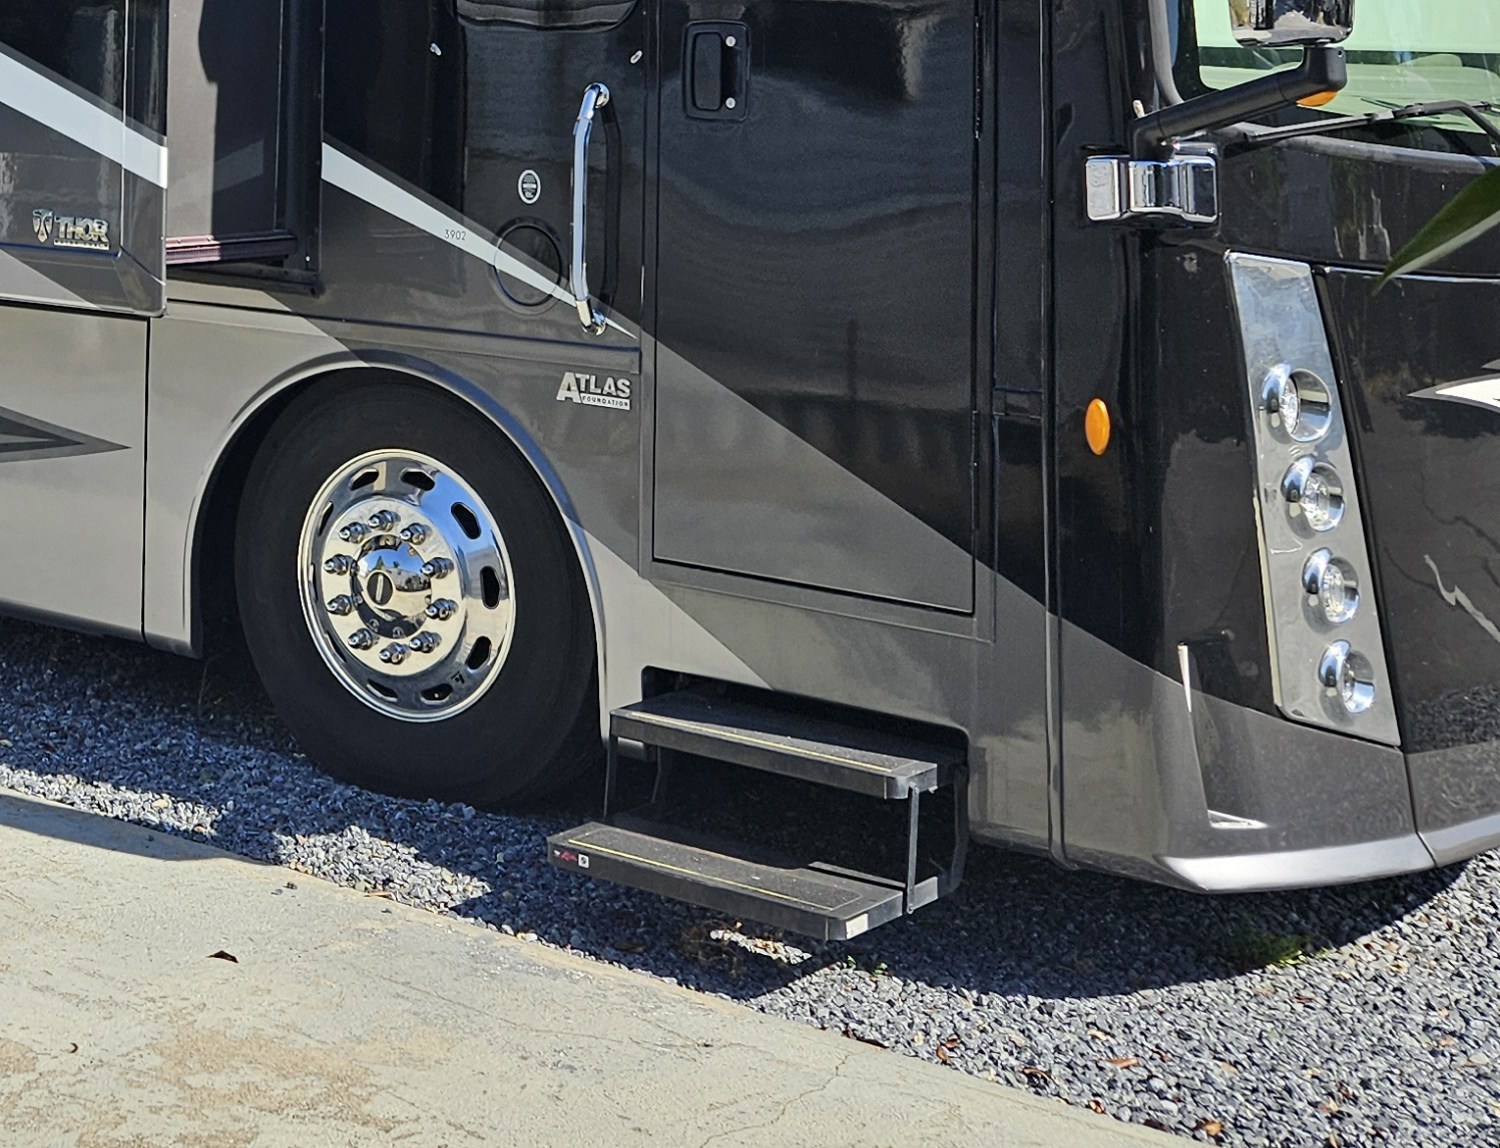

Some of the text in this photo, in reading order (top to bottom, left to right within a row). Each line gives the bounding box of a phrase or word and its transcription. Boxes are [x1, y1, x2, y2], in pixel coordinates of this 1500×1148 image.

[54, 216, 109, 243] THOR
[444, 228, 467, 240] 3902
[556, 371, 631, 403] ATLAS
[581, 394, 629, 408] FOUNDATION
